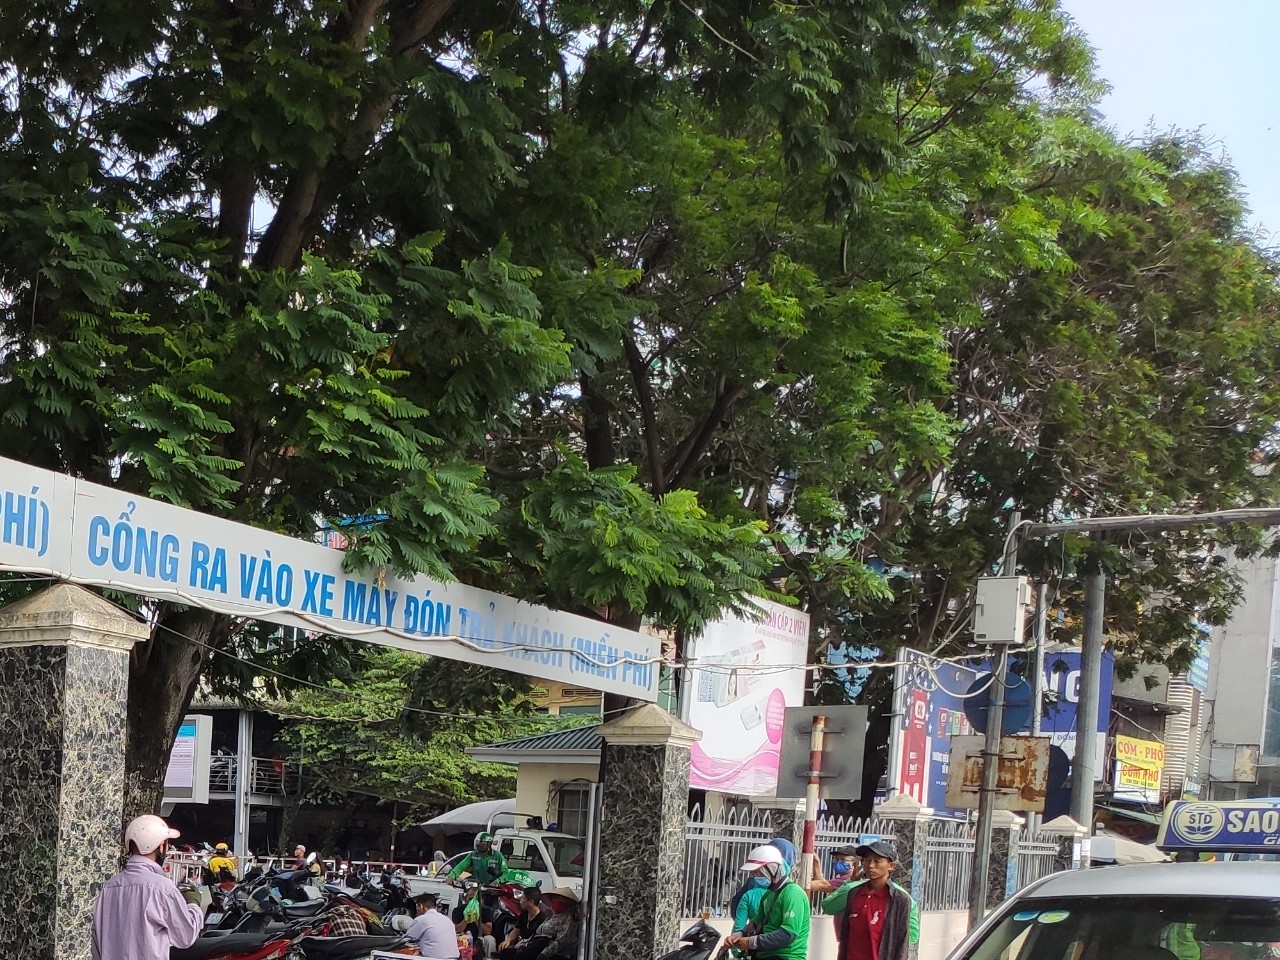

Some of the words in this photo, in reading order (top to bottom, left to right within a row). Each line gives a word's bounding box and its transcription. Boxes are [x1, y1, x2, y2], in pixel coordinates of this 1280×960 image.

[87, 500, 180, 583] CỔNG
[189, 541, 228, 594] RA
[239, 549, 294, 607] VÀO
[300, 569, 336, 617] XE
[342, 578, 399, 628] MÁY
[403, 590, 452, 638] ĐÓN
[1188, 812, 1213, 825] STD
[1227, 810, 1279, 834] SAO
